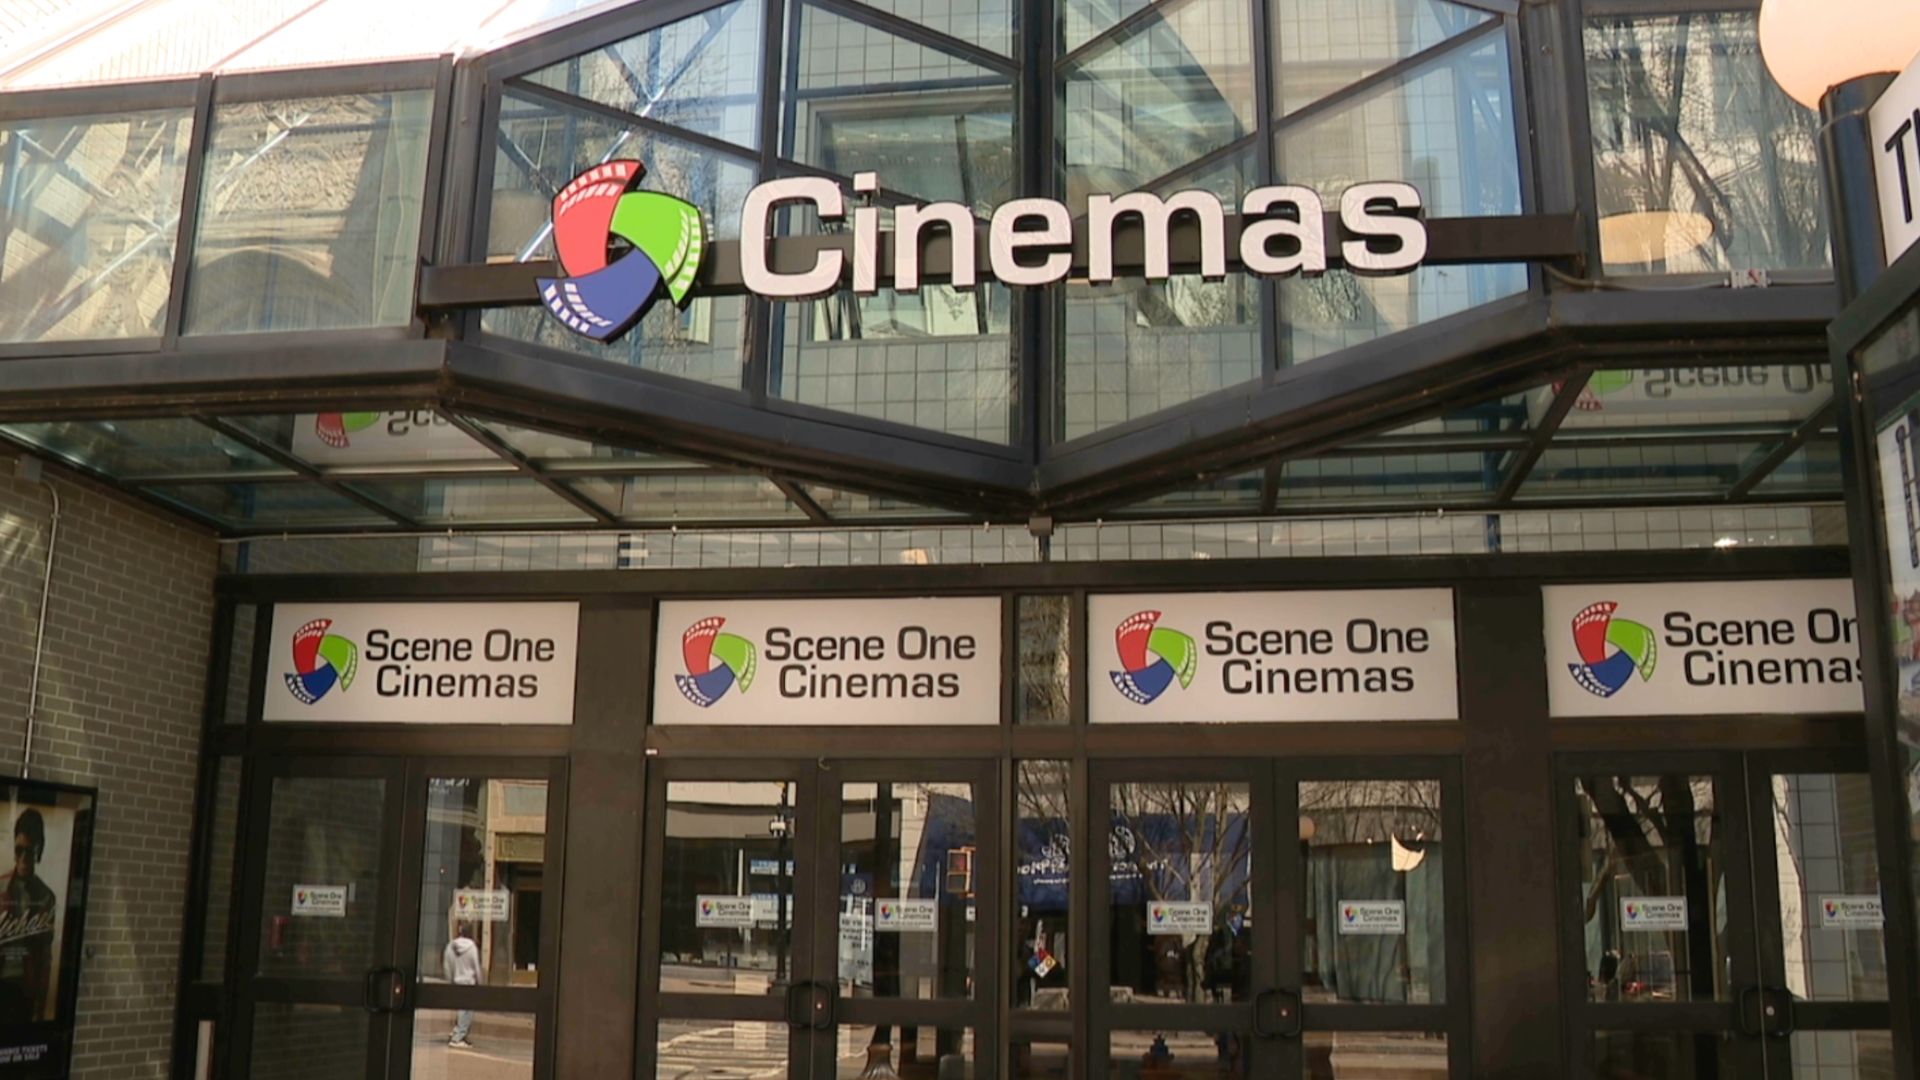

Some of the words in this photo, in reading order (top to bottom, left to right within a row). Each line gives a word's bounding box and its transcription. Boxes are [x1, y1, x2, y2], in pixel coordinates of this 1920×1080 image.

[741, 172, 1428, 297] Cinemas
[365, 628, 472, 662] Scene
[484, 629, 555, 662] One
[765, 627, 885, 661] Scene
[898, 625, 976, 660] One
[1205, 620, 1333, 656] Scene
[1346, 618, 1429, 654] One
[1663, 611, 1795, 648] Scene
[376, 664, 538, 698] Cinemas
[779, 664, 960, 698] Cinemas
[1222, 658, 1414, 694] Cinemas
